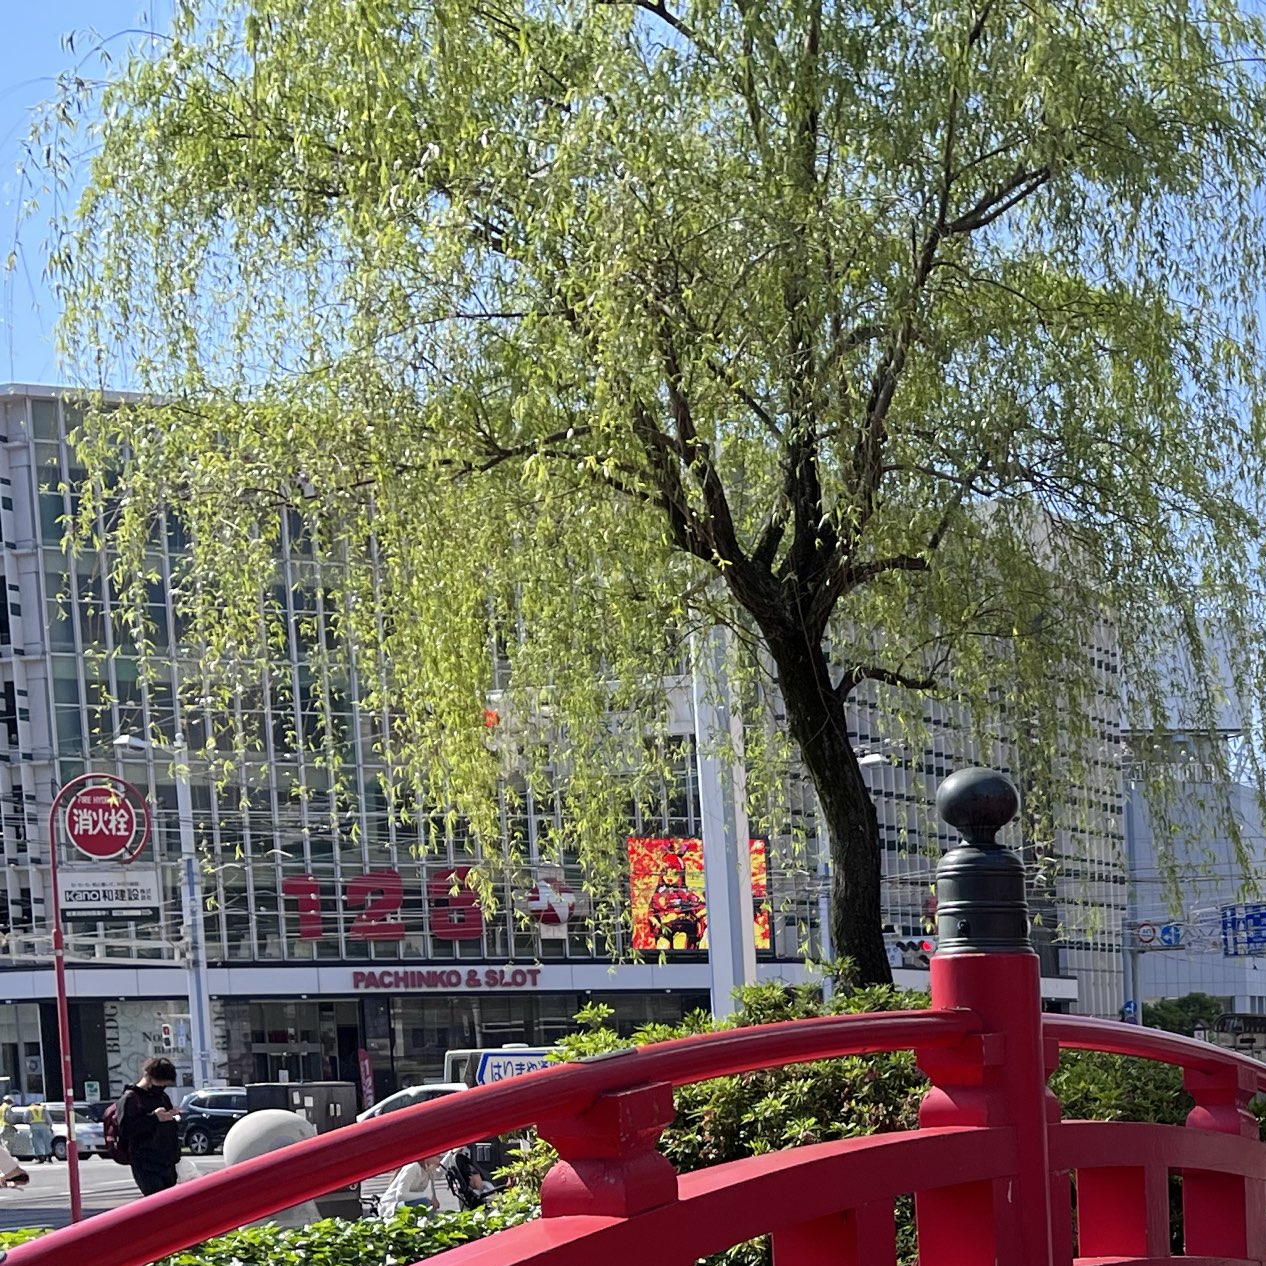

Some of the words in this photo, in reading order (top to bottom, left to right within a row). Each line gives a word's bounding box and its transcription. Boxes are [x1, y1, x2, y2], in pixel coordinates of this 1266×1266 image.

[72, 808, 130, 836] 消火栓
[353, 970, 461, 990] PACHINKO
[466, 969, 482, 988] &
[485, 968, 541, 988] SLOT
